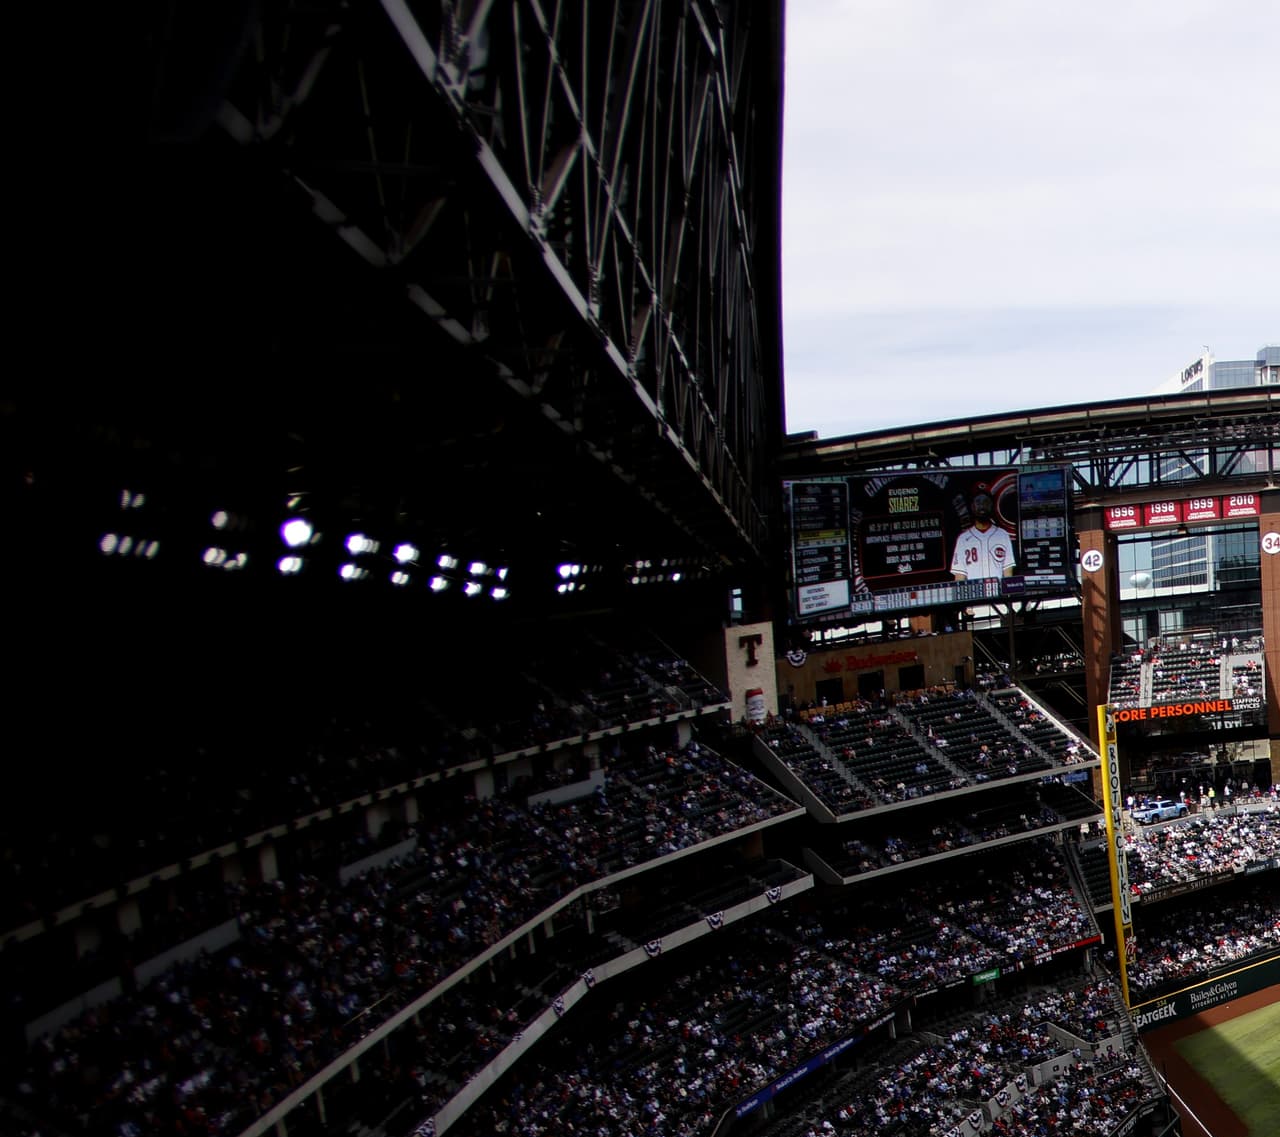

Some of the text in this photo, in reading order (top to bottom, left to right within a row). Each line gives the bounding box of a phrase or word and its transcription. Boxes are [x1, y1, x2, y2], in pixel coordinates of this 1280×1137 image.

[1181, 359, 1203, 383] LOEWS
[888, 488, 918, 496] EUGENIO
[1189, 499, 1214, 510] 1999
[1229, 494, 1254, 506] 2010
[1110, 507, 1134, 519] 1996
[1150, 502, 1175, 514] 1998
[1264, 536, 1280, 550] 34
[964, 546, 978, 564] 28
[1084, 553, 1101, 567] 42
[739, 634, 762, 667] T
[846, 651, 918, 671] Budweiser
[1113, 700, 1232, 722] CORE PERSONNEL
[1232, 703, 1260, 711] SERVICES
